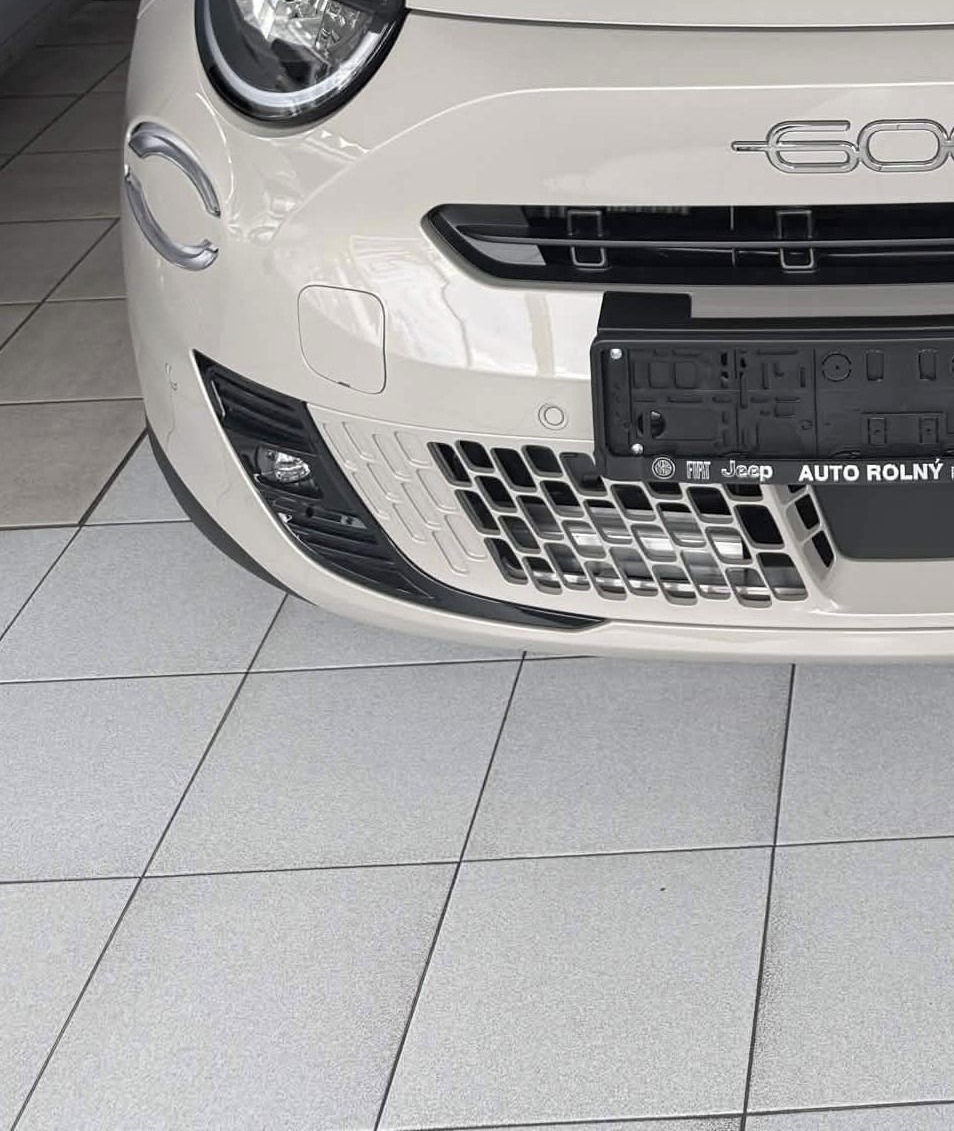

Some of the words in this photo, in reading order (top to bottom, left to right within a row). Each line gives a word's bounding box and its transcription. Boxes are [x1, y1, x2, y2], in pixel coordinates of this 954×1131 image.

[686, 460, 711, 480] FIAT
[721, 460, 774, 482] Jeep
[798, 464, 860, 482] AUTO
[866, 458, 944, 481] ROLNÝ
